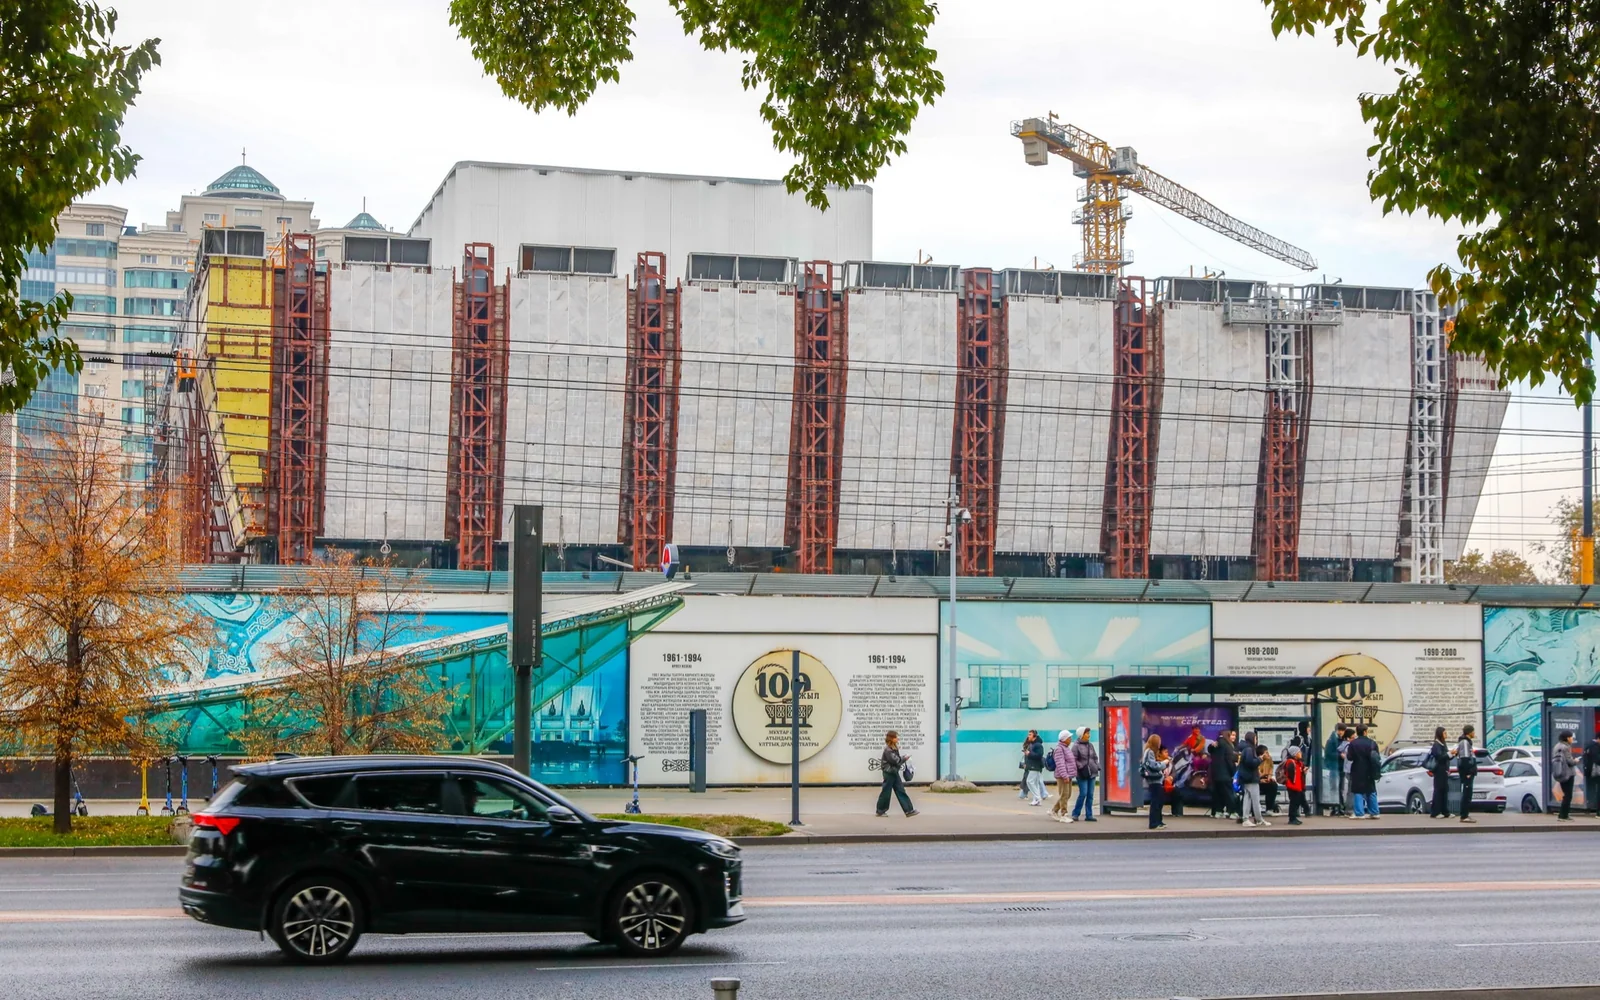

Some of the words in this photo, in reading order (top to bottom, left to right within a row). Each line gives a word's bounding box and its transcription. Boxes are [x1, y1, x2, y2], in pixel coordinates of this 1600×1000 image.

[1244, 647, 1278, 655] 1990-2000
[1424, 648, 1456, 656] 1990-2000
[662, 653, 702, 662] 1961-1994
[868, 655, 906, 663] 1961-1994
[755, 672, 811, 698] 100
